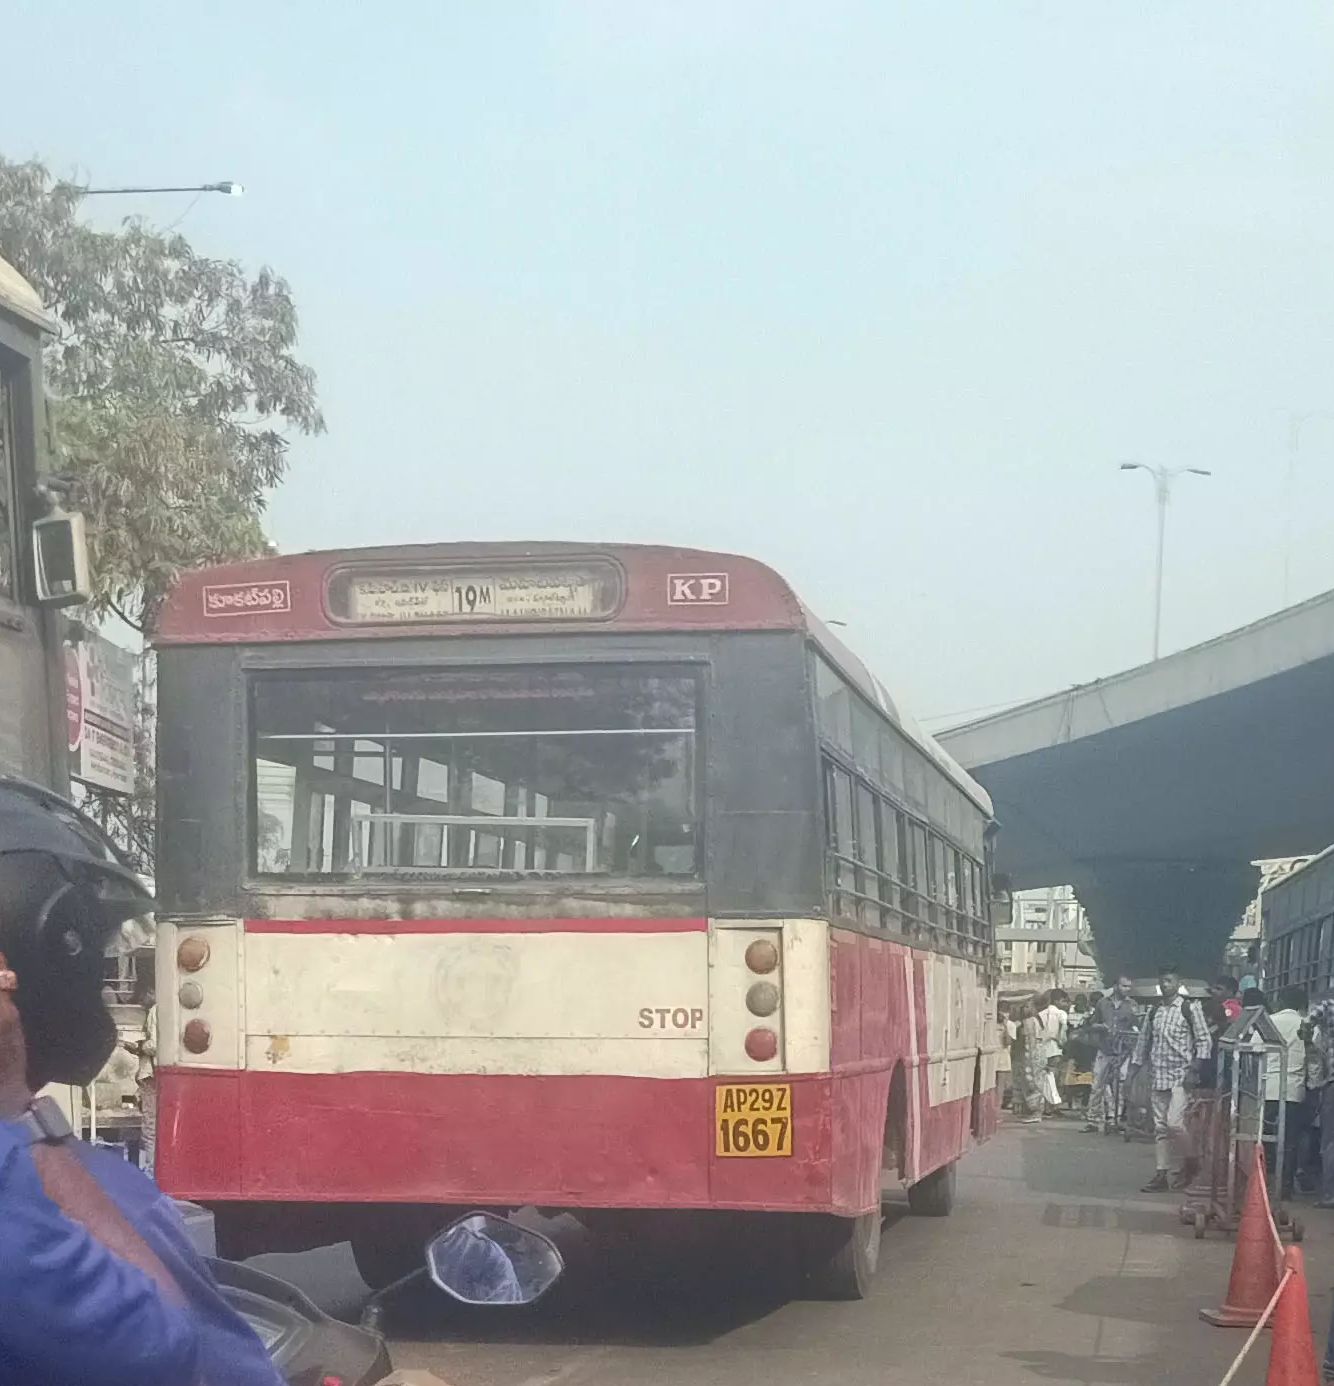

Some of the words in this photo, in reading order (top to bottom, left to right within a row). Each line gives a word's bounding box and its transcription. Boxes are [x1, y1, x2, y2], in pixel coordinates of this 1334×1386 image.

[672, 578, 722, 600] KP
[638, 1007, 704, 1029] STOP
[722, 1087, 788, 1113] AP29Z
[719, 1116, 789, 1153] 1667
